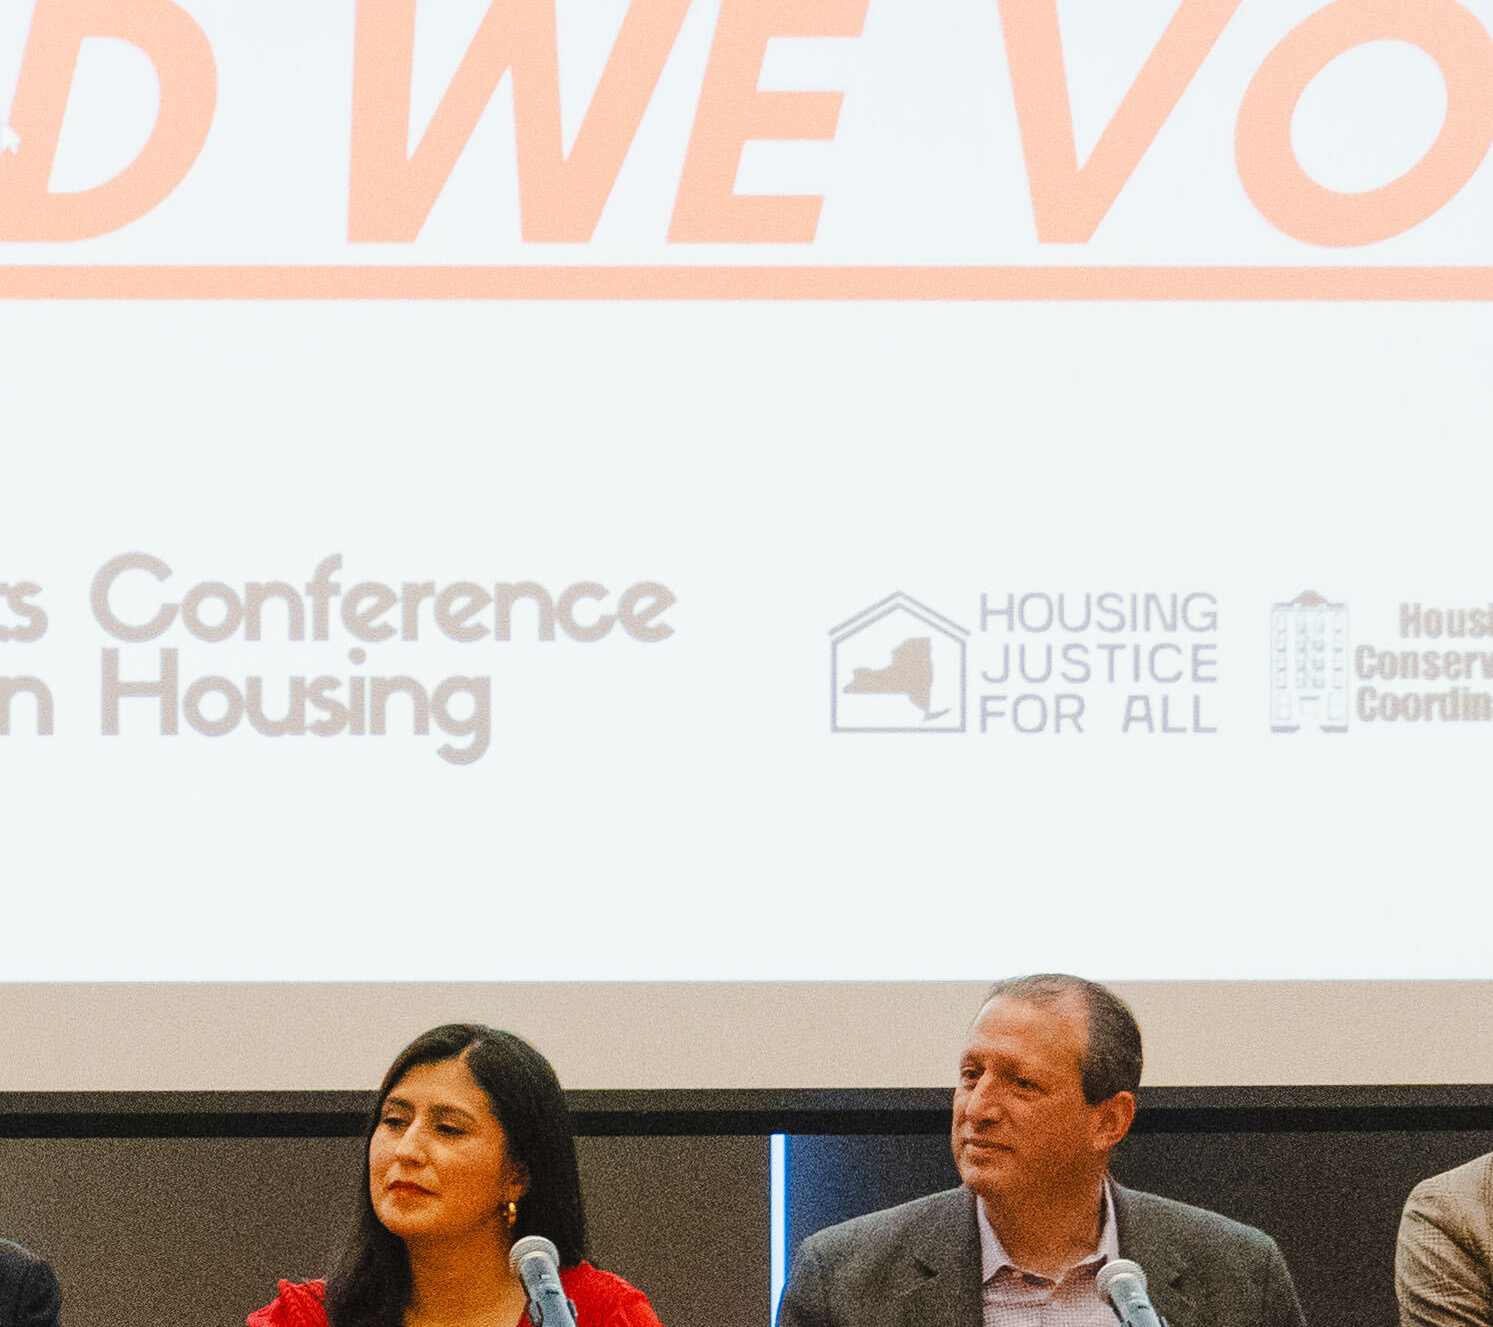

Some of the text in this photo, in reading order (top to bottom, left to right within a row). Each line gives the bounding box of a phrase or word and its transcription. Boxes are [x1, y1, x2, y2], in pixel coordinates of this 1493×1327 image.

[89, 551, 678, 644] Conference
[979, 591, 1219, 635] HOUSING
[979, 641, 1219, 686] JUSTICE
[100, 648, 493, 767] Housing
[979, 691, 1219, 735] FOR ALL
